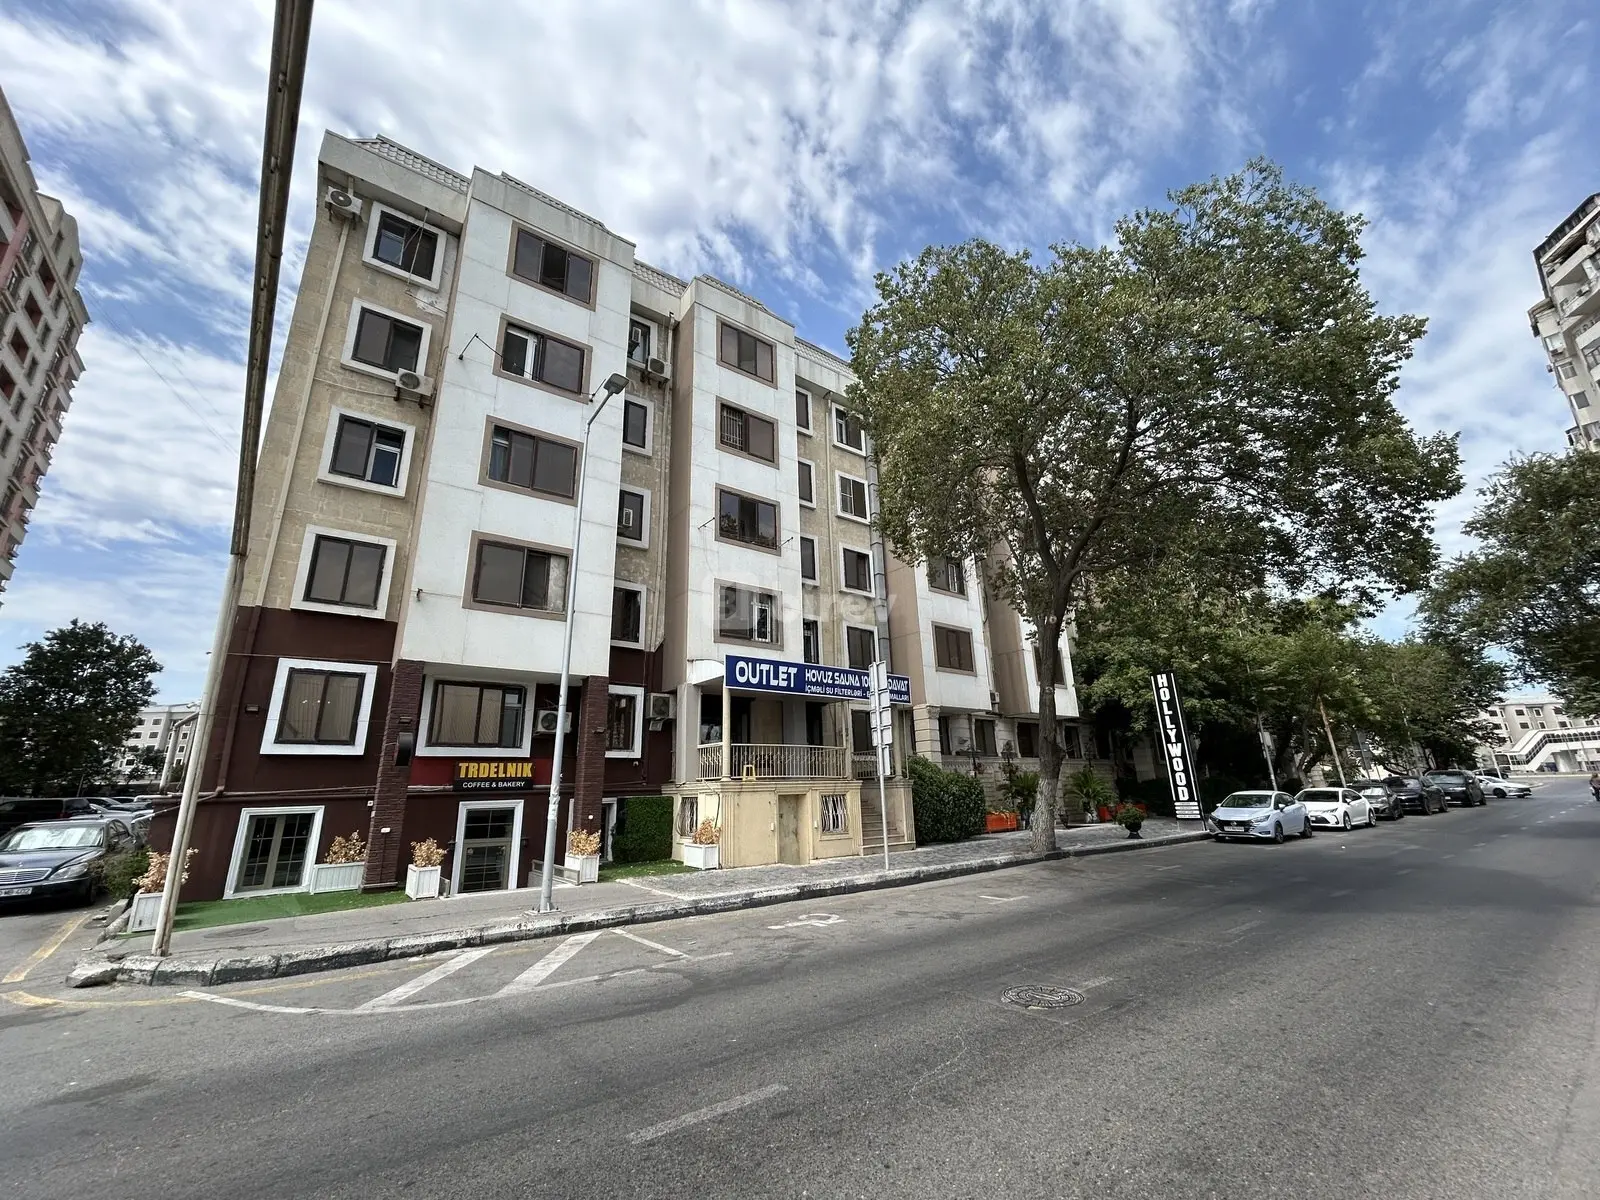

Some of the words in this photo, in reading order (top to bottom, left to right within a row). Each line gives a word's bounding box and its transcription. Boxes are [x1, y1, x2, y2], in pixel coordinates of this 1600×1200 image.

[735, 660, 798, 688] OUTLET
[805, 669, 833, 683] HOVUZ
[834, 672, 861, 687] SAUNA
[826, 686, 834, 694] SU
[1156, 673, 1189, 801] HOLLYWOOD
[458, 762, 533, 778] TRDELNIK
[462, 781, 490, 789] COFFEE
